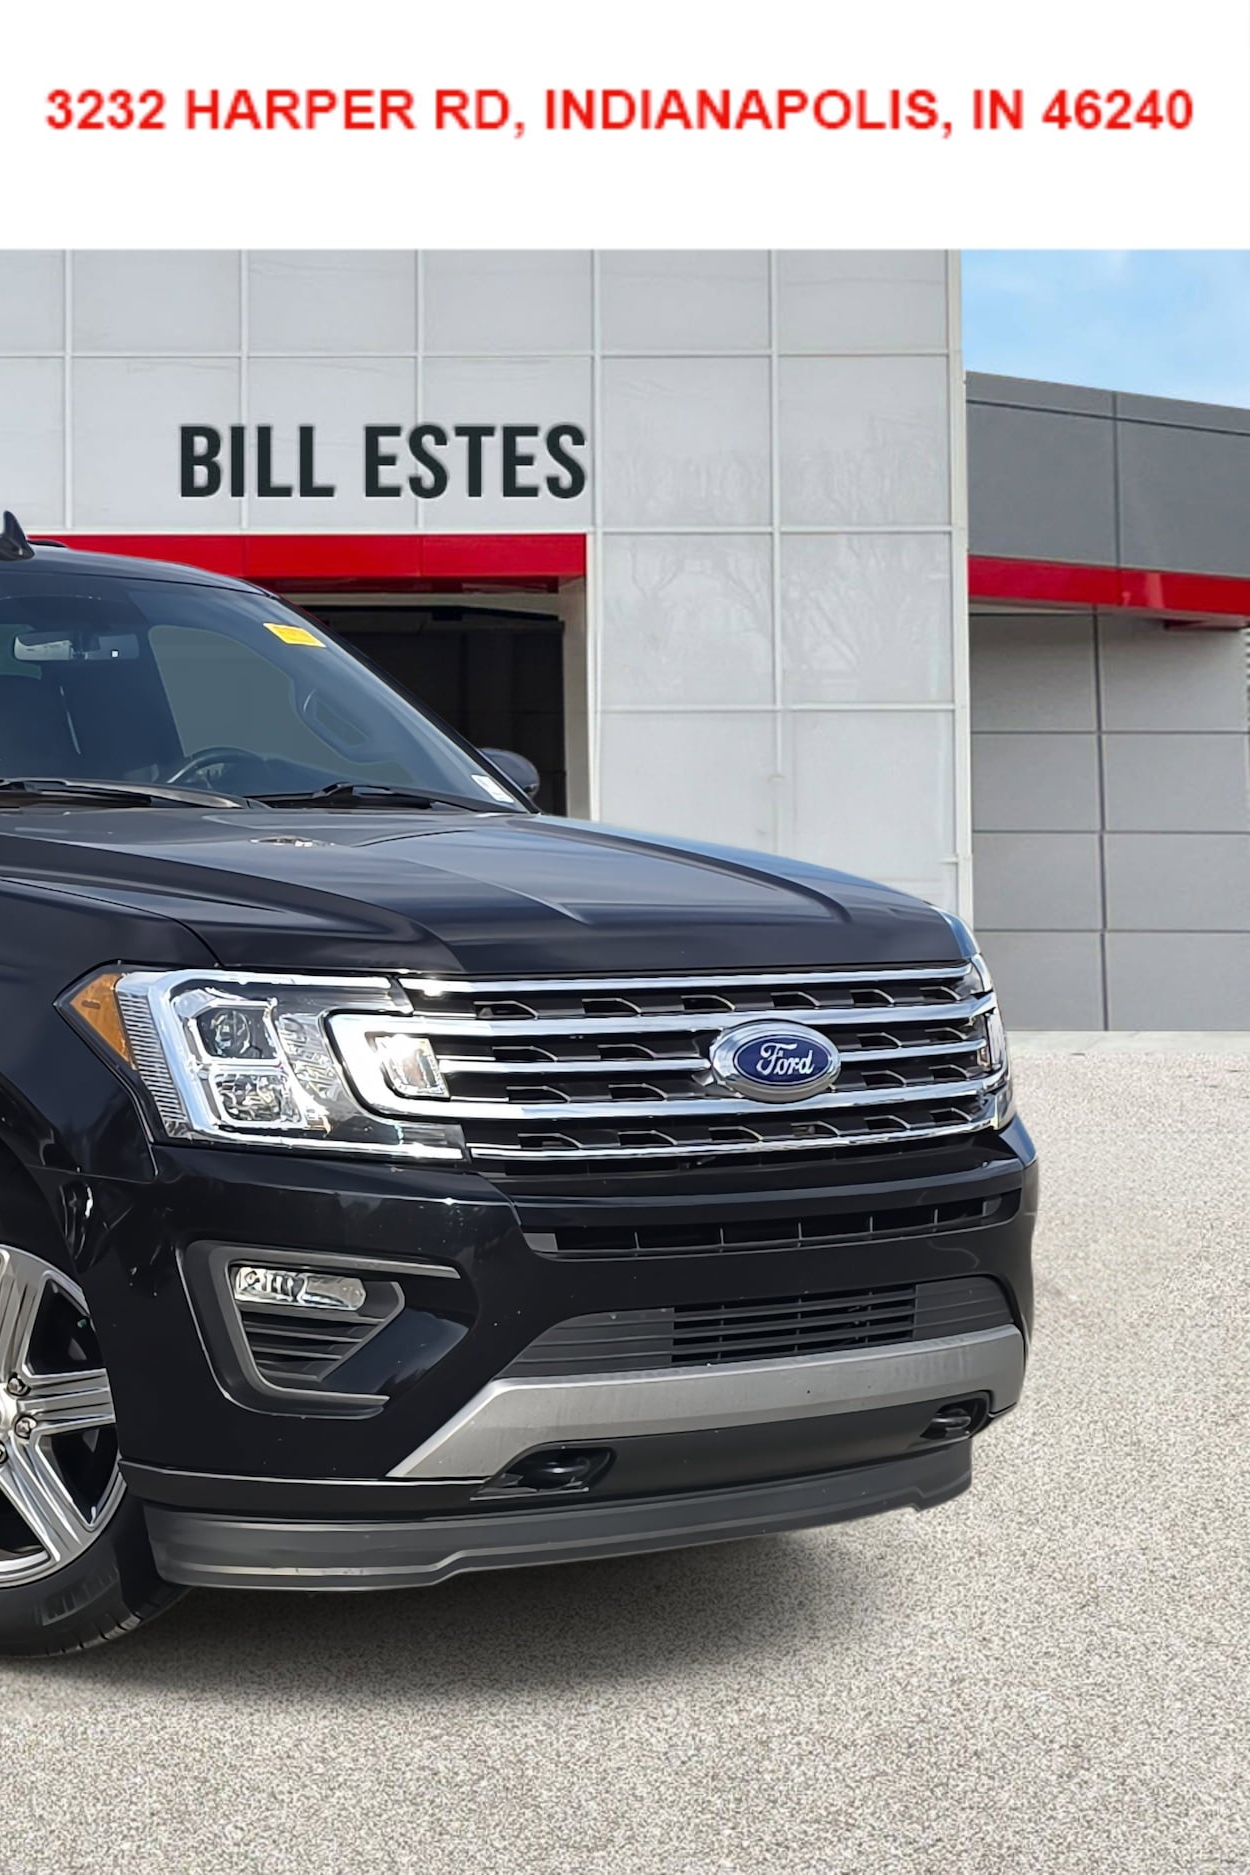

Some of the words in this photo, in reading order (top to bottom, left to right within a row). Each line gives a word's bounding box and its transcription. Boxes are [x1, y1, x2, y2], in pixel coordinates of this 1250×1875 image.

[180, 426, 335, 498] BILL
[365, 424, 587, 499] ESTES
[755, 1041, 816, 1076] Ford
